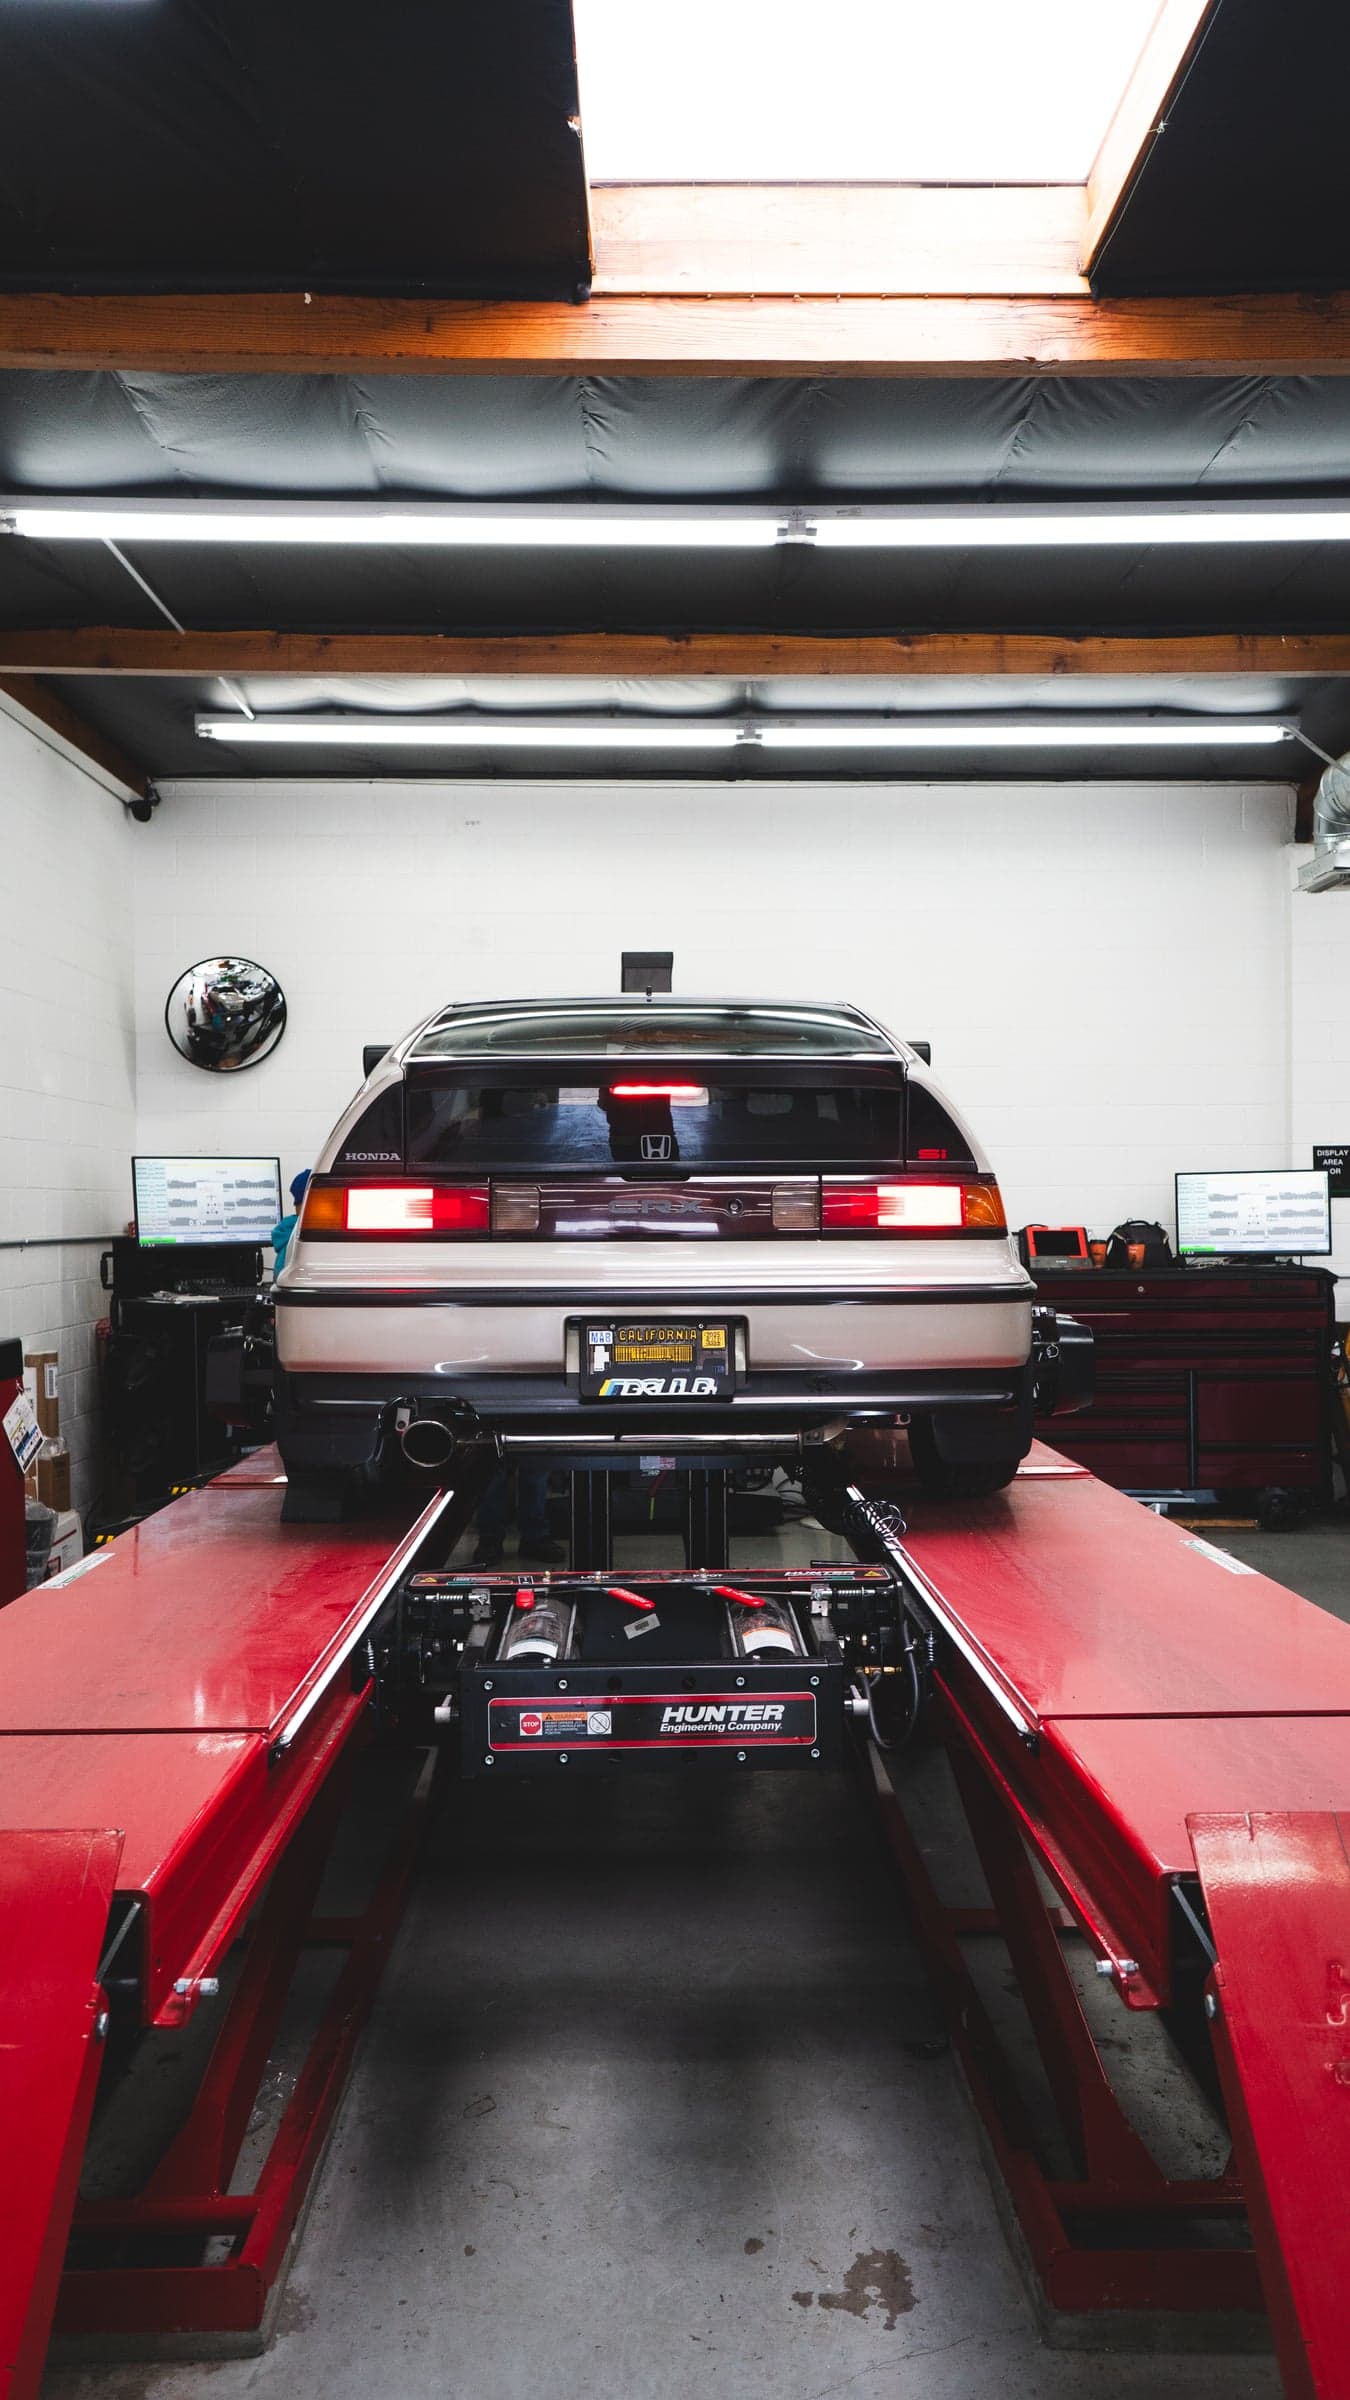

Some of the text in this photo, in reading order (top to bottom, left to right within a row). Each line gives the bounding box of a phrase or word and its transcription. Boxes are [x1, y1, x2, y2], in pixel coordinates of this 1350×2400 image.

[344, 1152, 401, 1161] HONDA
[917, 1148, 947, 1160] Si
[1316, 1149, 1349, 1157] DISPLAY
[1322, 1158, 1344, 1166] AREA
[1329, 1167, 1342, 1175] OR
[607, 1199, 704, 1214] CRX
[618, 1328, 698, 1342] CALIFORNIA
[662, 1704, 785, 1722] HUNTER
[660, 1722, 726, 1733] Engineering
